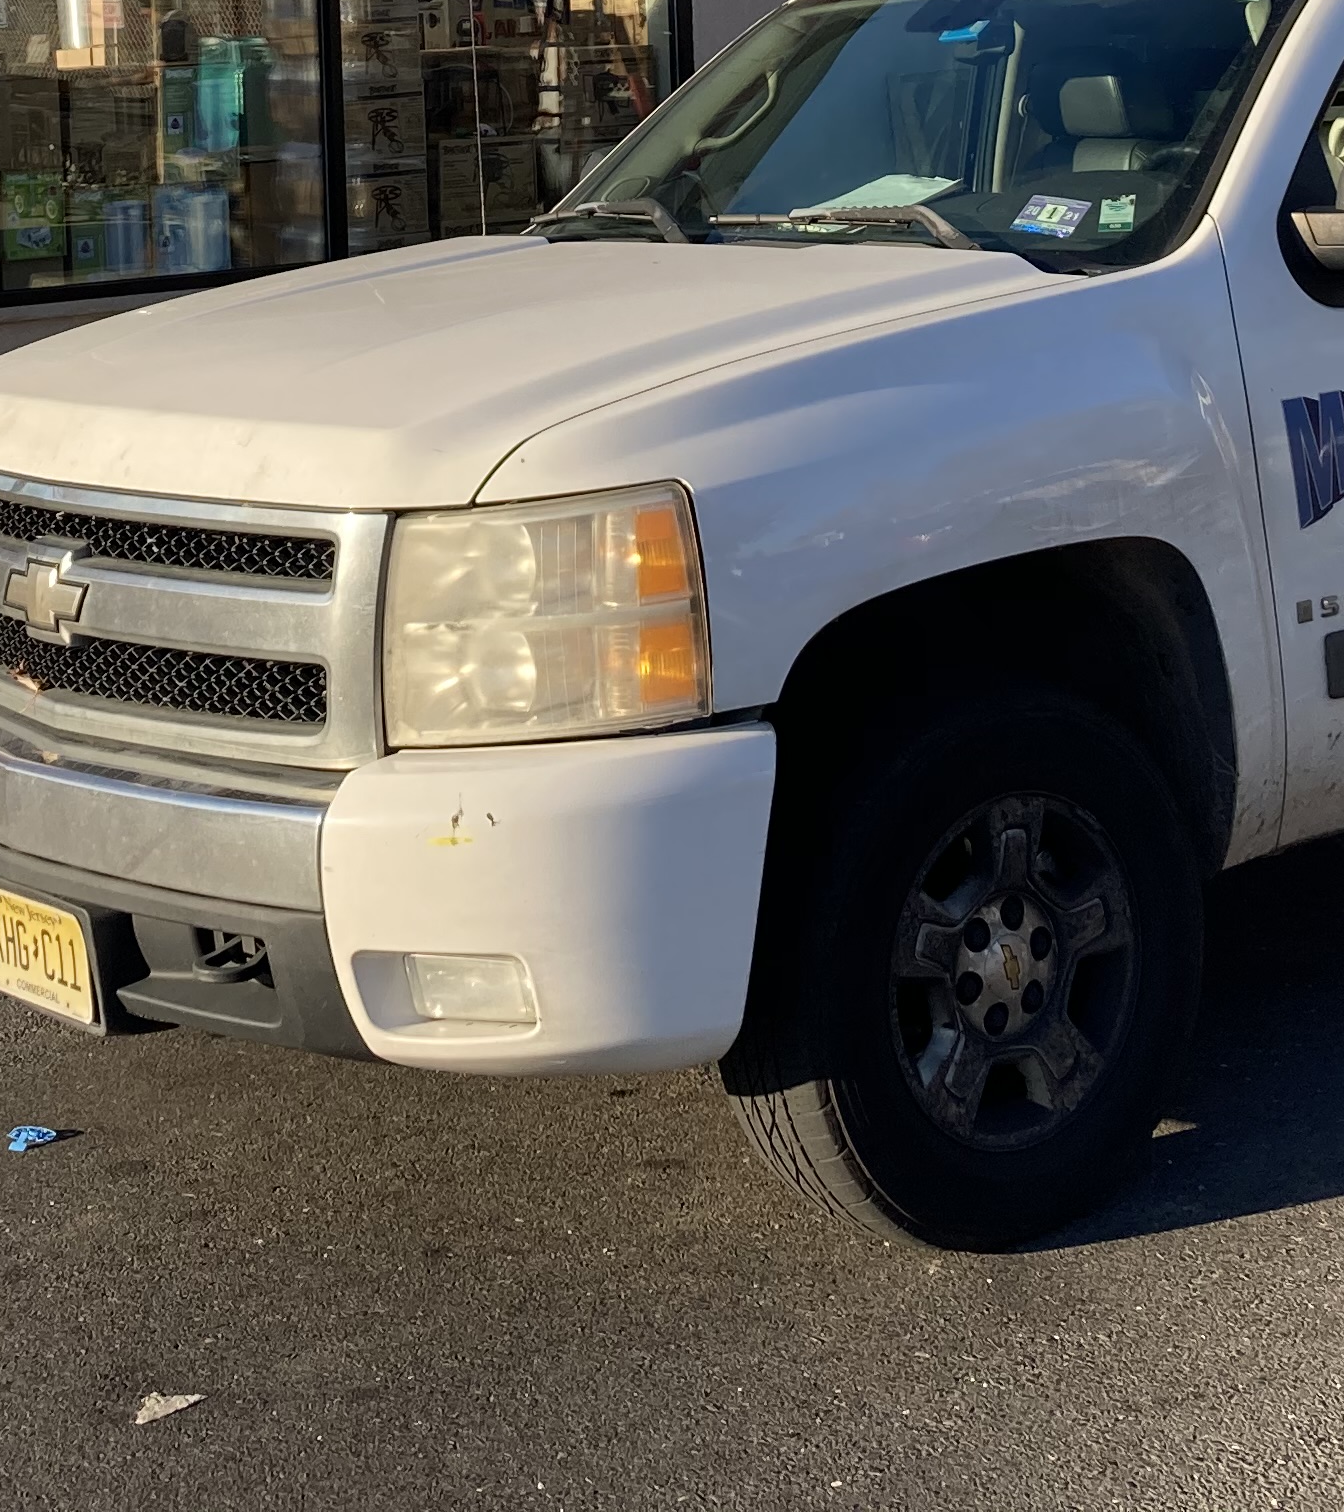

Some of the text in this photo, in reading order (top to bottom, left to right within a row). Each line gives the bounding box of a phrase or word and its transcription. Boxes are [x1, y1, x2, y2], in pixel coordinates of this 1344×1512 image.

[1024, 205, 1079, 222] 20 1 21
[0, 894, 59, 929] New Jersey
[16, 978, 60, 1005] COMMERCIAL
